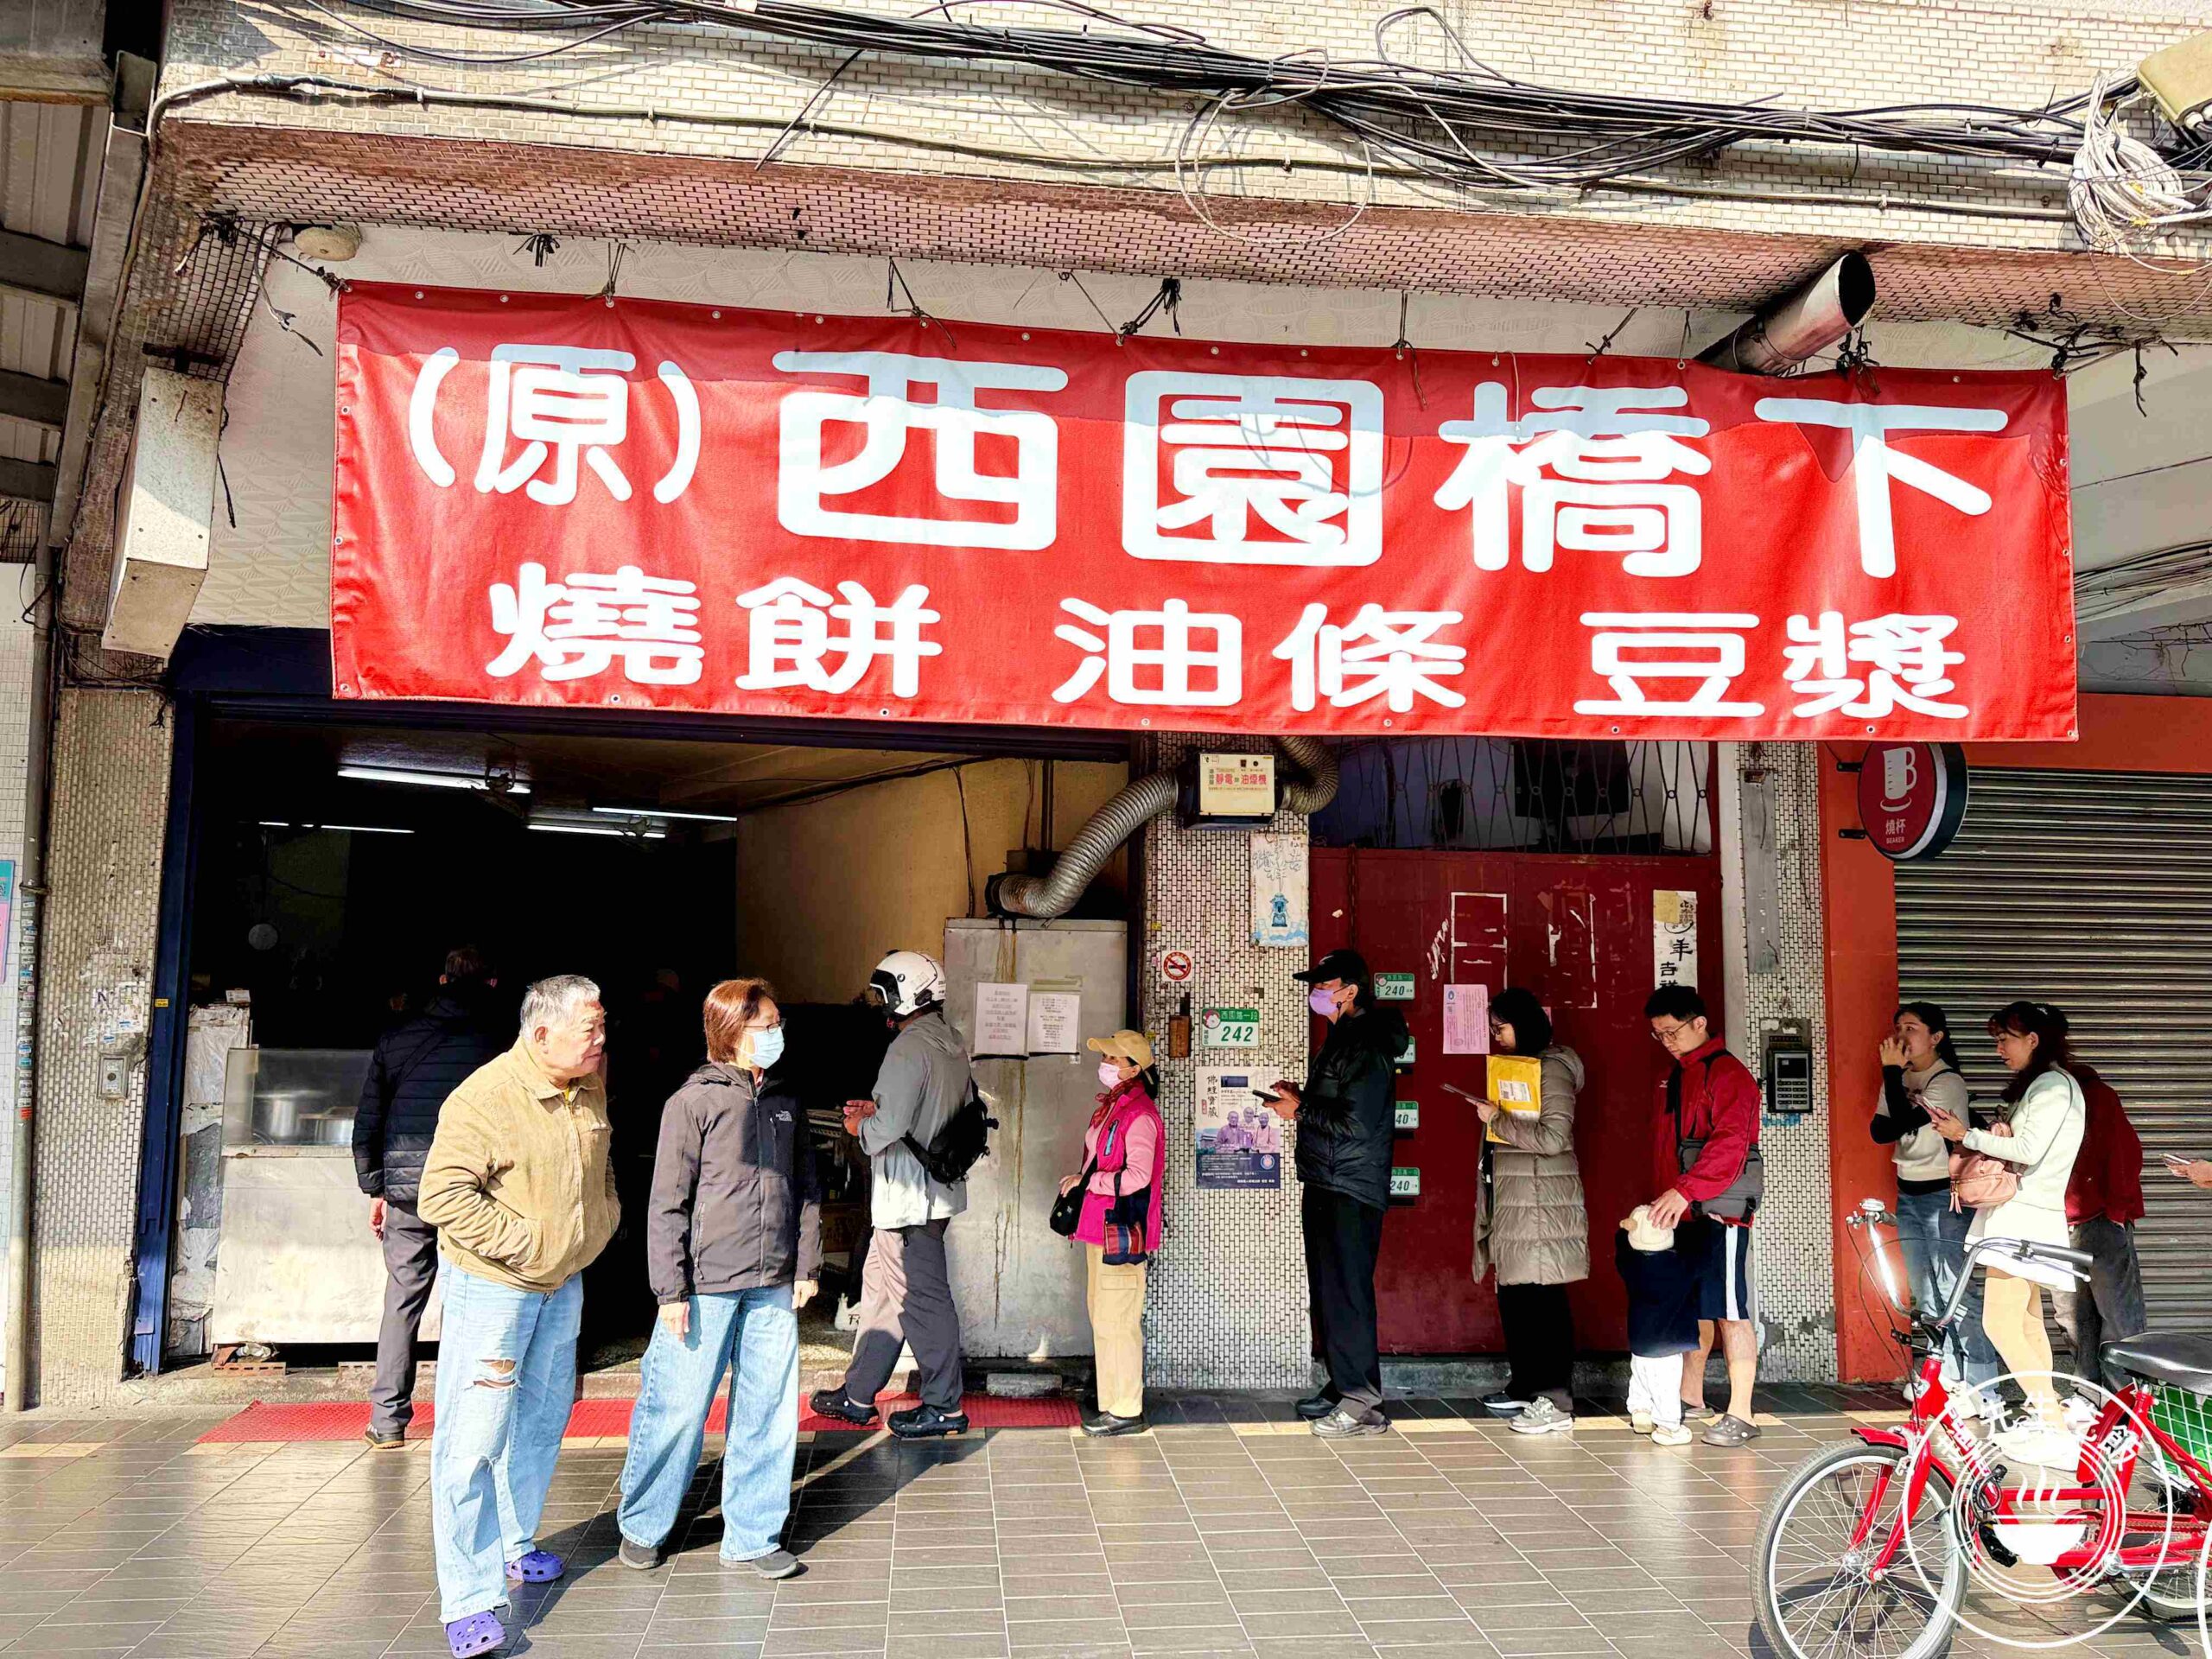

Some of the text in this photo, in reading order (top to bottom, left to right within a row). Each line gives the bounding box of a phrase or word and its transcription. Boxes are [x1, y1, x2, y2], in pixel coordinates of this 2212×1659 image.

[486, 556, 1971, 728] 燒餅 油條 豆漿
[1385, 985, 1405, 996] 240
[1221, 1026, 1254, 1042] 242
[1395, 1114, 1408, 1124] 40
[1390, 1180, 1409, 1191] 240
